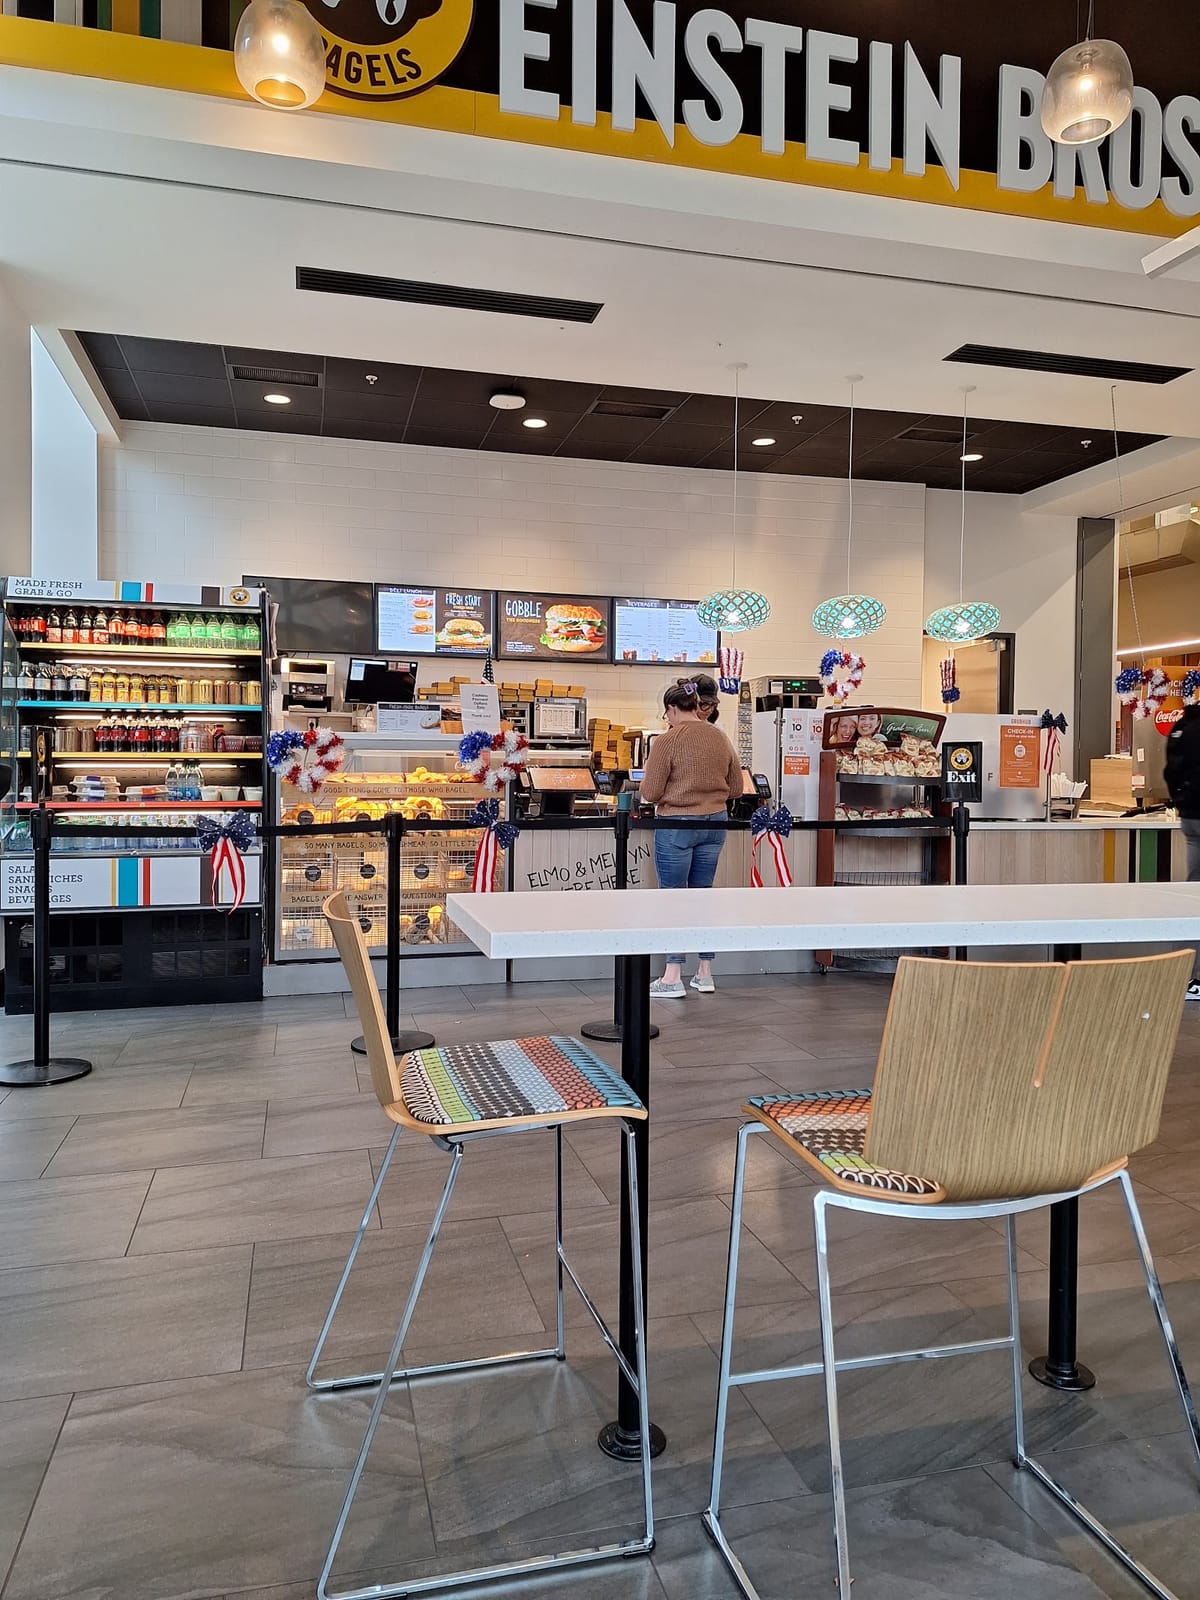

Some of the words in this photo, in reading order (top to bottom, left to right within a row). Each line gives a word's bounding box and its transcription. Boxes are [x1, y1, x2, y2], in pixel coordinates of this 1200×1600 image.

[321, 35, 422, 87] AGELS
[498, 0, 962, 192] EINSTEIN
[15, 579, 47, 588] MADE
[49, 580, 82, 589] FRESH
[14, 587, 44, 596] GRAB
[46, 589, 53, 597] &
[56, 589, 73, 598] GO
[445, 593, 463, 606] FRESH
[464, 594, 482, 607] START
[505, 599, 542, 618] GOBBLE
[722, 678, 736, 689] US
[792, 723, 802, 731] 10
[812, 725, 823, 733] 10
[946, 770, 977, 783] Exit
[344, 786, 371, 794] THINGS
[373, 786, 391, 794] COME
[368, 841, 378, 849] SO
[440, 840, 464, 848] LITTLE
[8, 874, 84, 884] SANICHES
[527, 866, 571, 888] ELMO
[575, 861, 587, 877] &
[8, 894, 72, 904] BEVEGES
[291, 895, 320, 903] BAGELS
